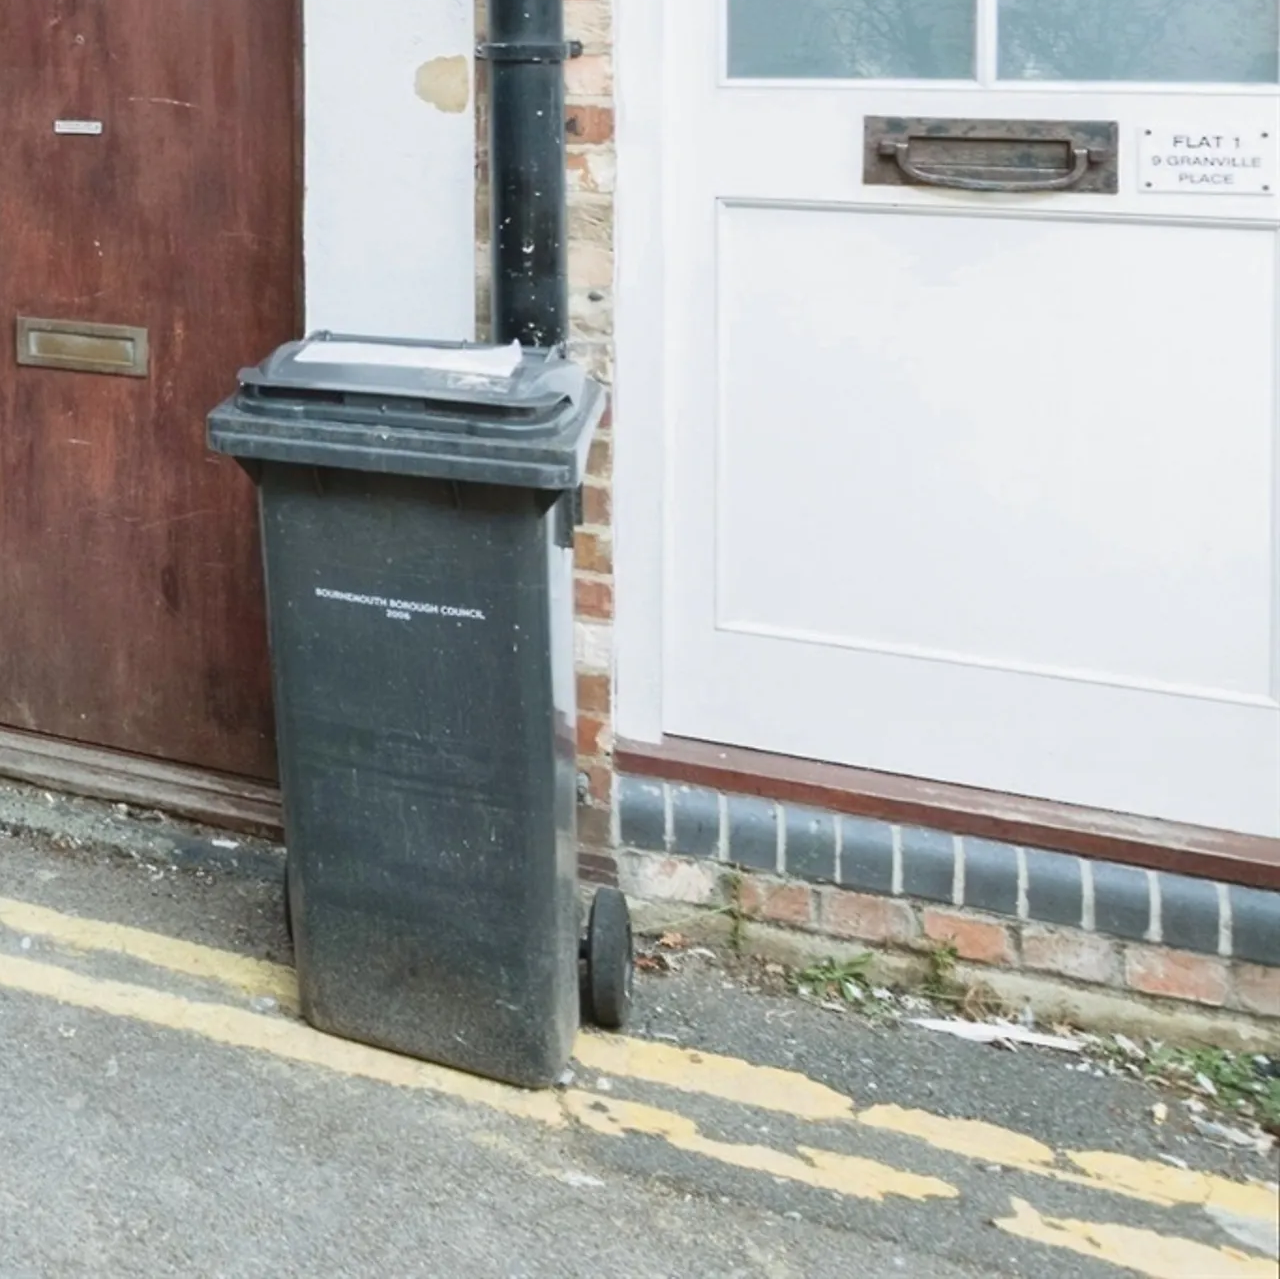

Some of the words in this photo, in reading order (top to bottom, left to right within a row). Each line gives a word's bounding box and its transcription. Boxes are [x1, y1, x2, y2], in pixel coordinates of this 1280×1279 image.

[1172, 135, 1223, 149] FLAT
[1233, 136, 1241, 149] 1
[1166, 155, 1261, 168] GRANVILLE
[1178, 173, 1234, 185] PLACE
[315, 587, 387, 606] BOURNEMOUTH
[389, 599, 438, 614] BOROUGH
[440, 605, 486, 620] COUNCIL
